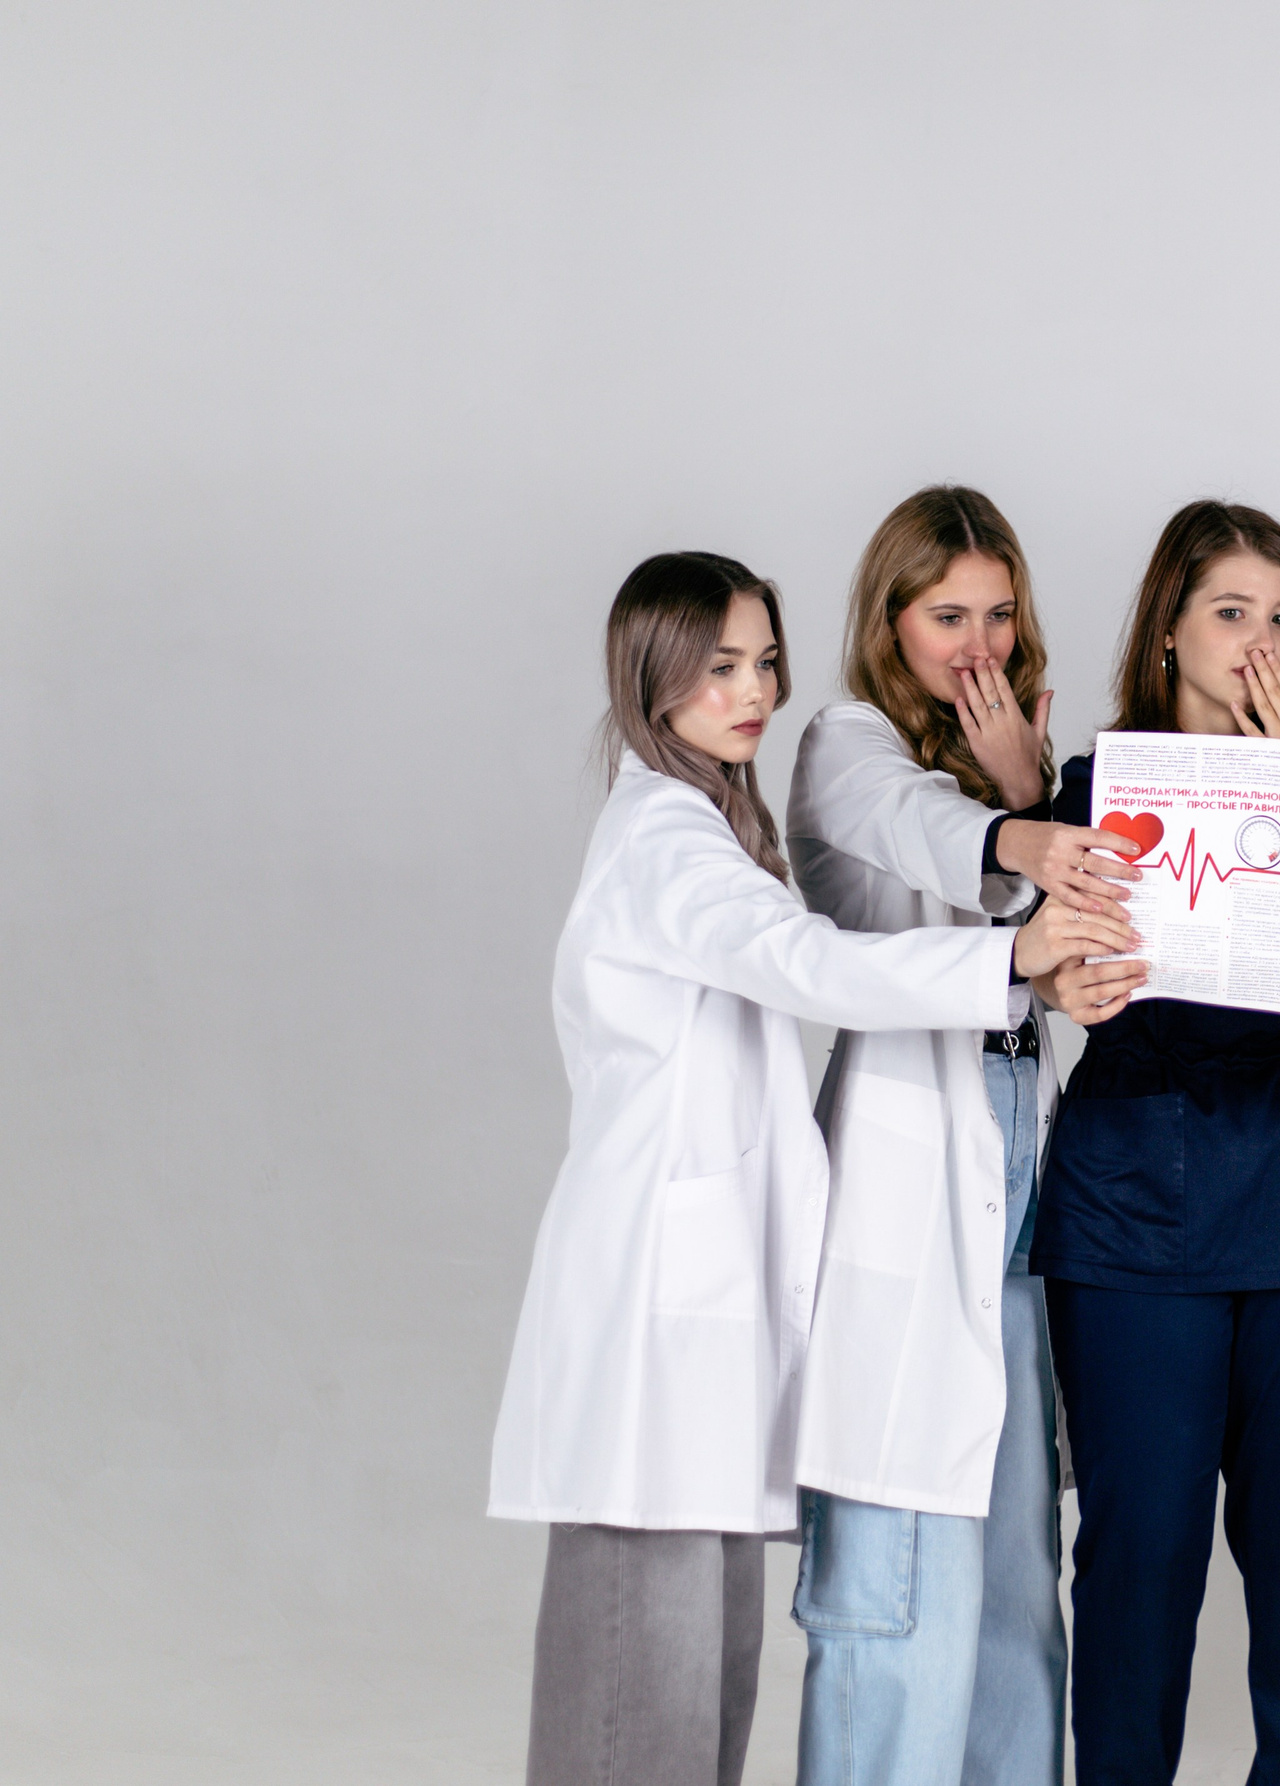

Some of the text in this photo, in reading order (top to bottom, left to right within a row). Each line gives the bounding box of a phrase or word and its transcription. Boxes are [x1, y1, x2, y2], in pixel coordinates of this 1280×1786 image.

[1109, 785, 1199, 797] ПРОФИЛАКТИКА
[1104, 797, 1173, 808] ГИПЕРТОНИИ
[1187, 800, 1237, 811] ПРОСТЫЕ
